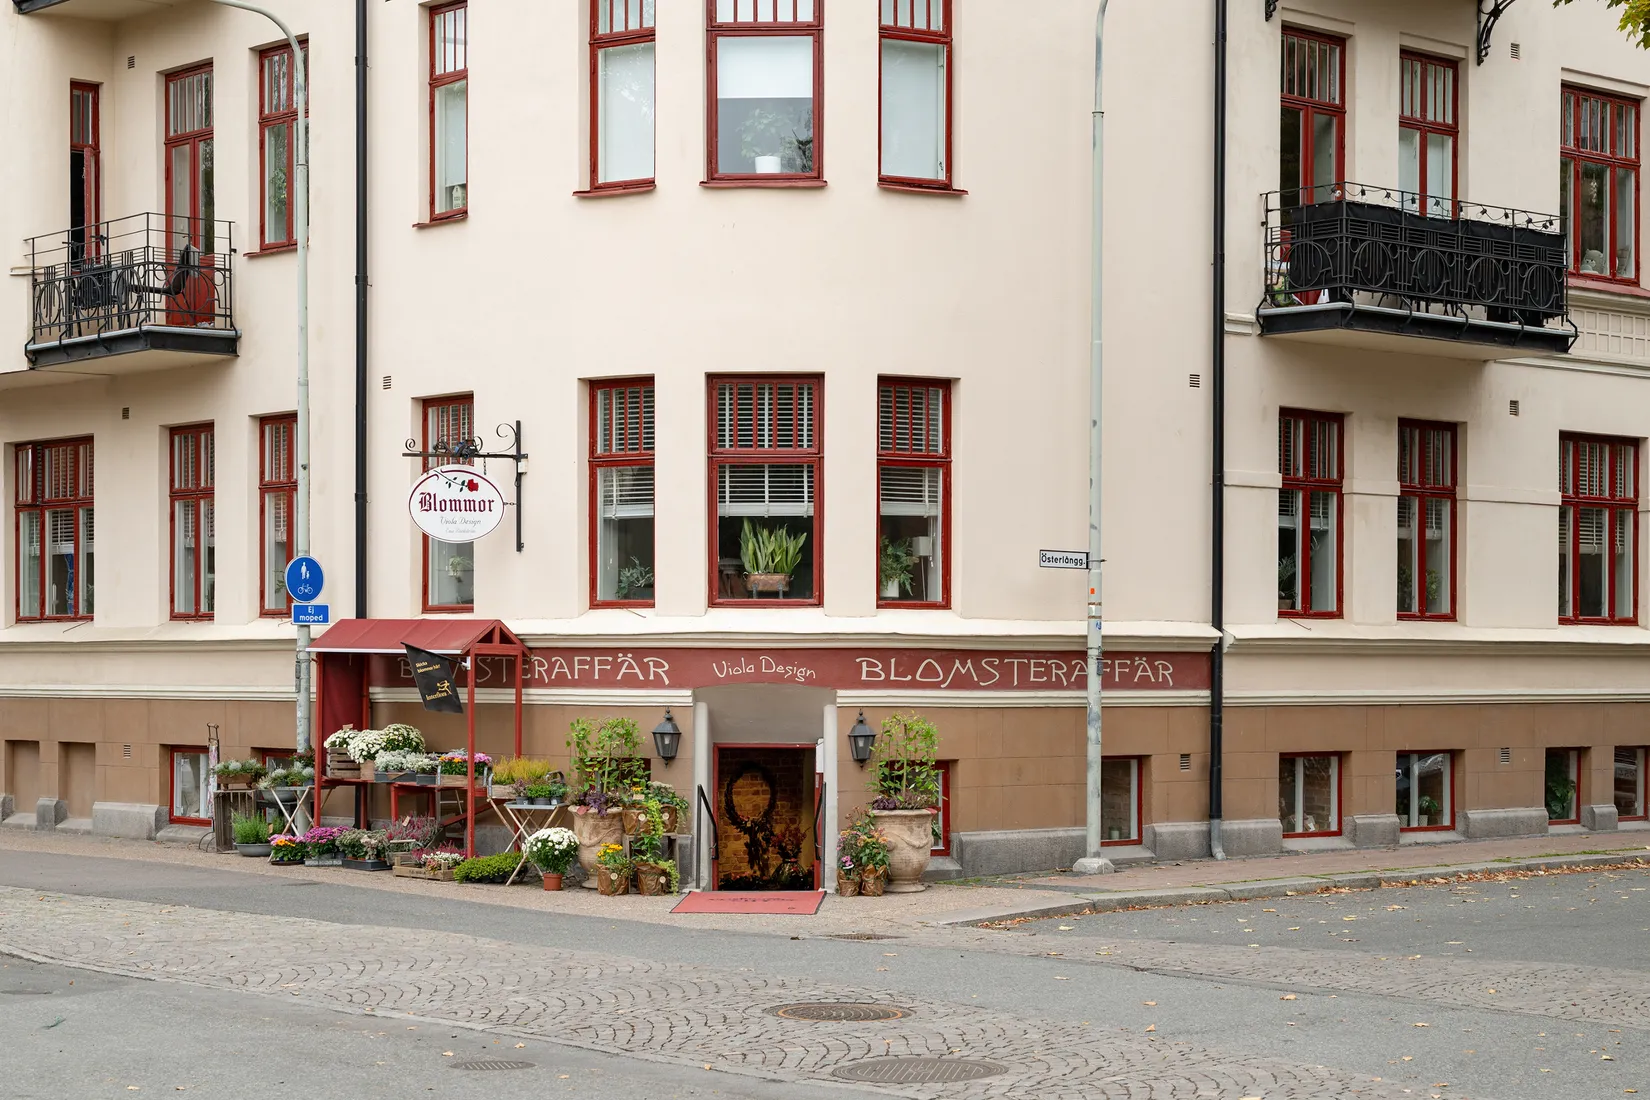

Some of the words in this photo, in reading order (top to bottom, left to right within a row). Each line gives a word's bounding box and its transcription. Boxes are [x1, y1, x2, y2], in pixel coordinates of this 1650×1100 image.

[419, 491, 495, 513] Blommor
[459, 516, 482, 528] Design
[1041, 552, 1086, 566] Österlångg.
[308, 606, 315, 614] Ej
[712, 657, 755, 678] Viola
[759, 655, 816, 682] Design
[855, 656, 1174, 689] BLOMSTERAFFÄR
